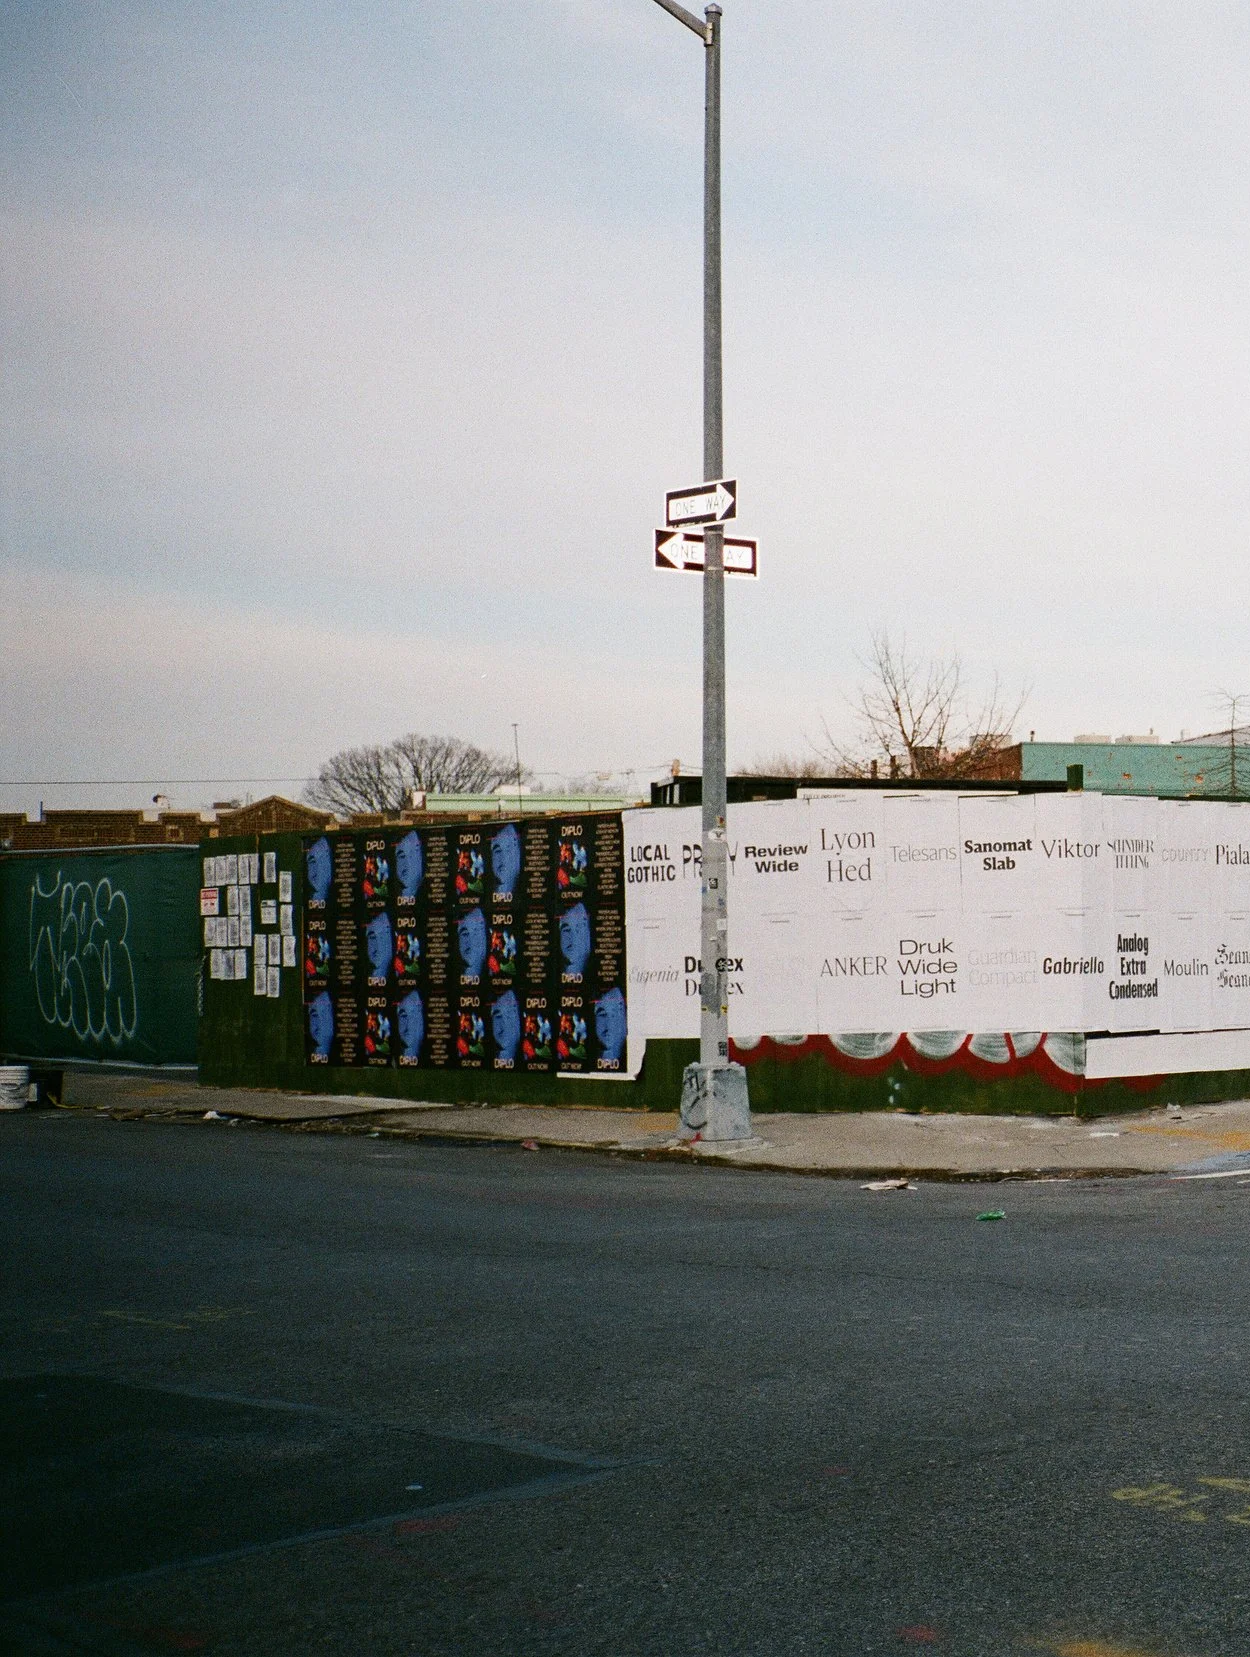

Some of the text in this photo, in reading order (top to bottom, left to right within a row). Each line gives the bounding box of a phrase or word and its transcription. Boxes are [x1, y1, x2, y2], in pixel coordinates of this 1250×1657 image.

[675, 496, 725, 516] ONE WAY
[670, 543, 698, 560] ONE
[561, 825, 583, 837] DIPLO
[366, 840, 385, 851] DIPLO
[459, 834, 480, 845] DIPLO
[821, 828, 875, 855] Lyon
[964, 839, 1032, 853] Sanomat
[631, 845, 670, 862] LOCAL
[744, 844, 808, 859] Review
[890, 845, 957, 863] Telesans
[1041, 839, 1100, 858] Viktor
[1162, 848, 1208, 863] COUNTY
[755, 860, 799, 873] Wide
[827, 857, 871, 882] Hed
[983, 857, 1016, 871] Slab
[628, 865, 675, 883] GOTHIC
[309, 900, 326, 909] DIPLO
[397, 896, 416, 906] DIPLO
[492, 892, 513, 903] DIPLO
[309, 921, 326, 931] DIPLO
[397, 917, 416, 928] DIPLO
[492, 914, 513, 925] DIPLO
[900, 938, 953, 955] Druk
[1117, 933, 1149, 955] Analog
[685, 956, 743, 973] Dex
[968, 949, 1037, 966] Guardian
[820, 956, 887, 977] ANKER
[897, 959, 957, 975] Wide
[1043, 957, 1104, 975] Gabriello
[1120, 957, 1147, 976] Extra
[1164, 959, 1209, 977] Moulin
[368, 976, 387, 987] DIPLO
[460, 975, 480, 986] DIPLO
[561, 973, 583, 984] DIPLO
[969, 968, 1038, 987] Compact
[685, 979, 744, 996] Dex
[900, 978, 956, 998] Light
[1109, 978, 1158, 1000] Condensed
[368, 997, 387, 1008] DIPLO
[460, 996, 480, 1007] DIPLO
[526, 997, 547, 1009] DIPLO
[561, 996, 583, 1008] DIPLO
[311, 1053, 328, 1064] DIPLO
[399, 1056, 418, 1066] DIPLO
[494, 1058, 515, 1069] DIPLO
[597, 1058, 619, 1070] DIPLO
